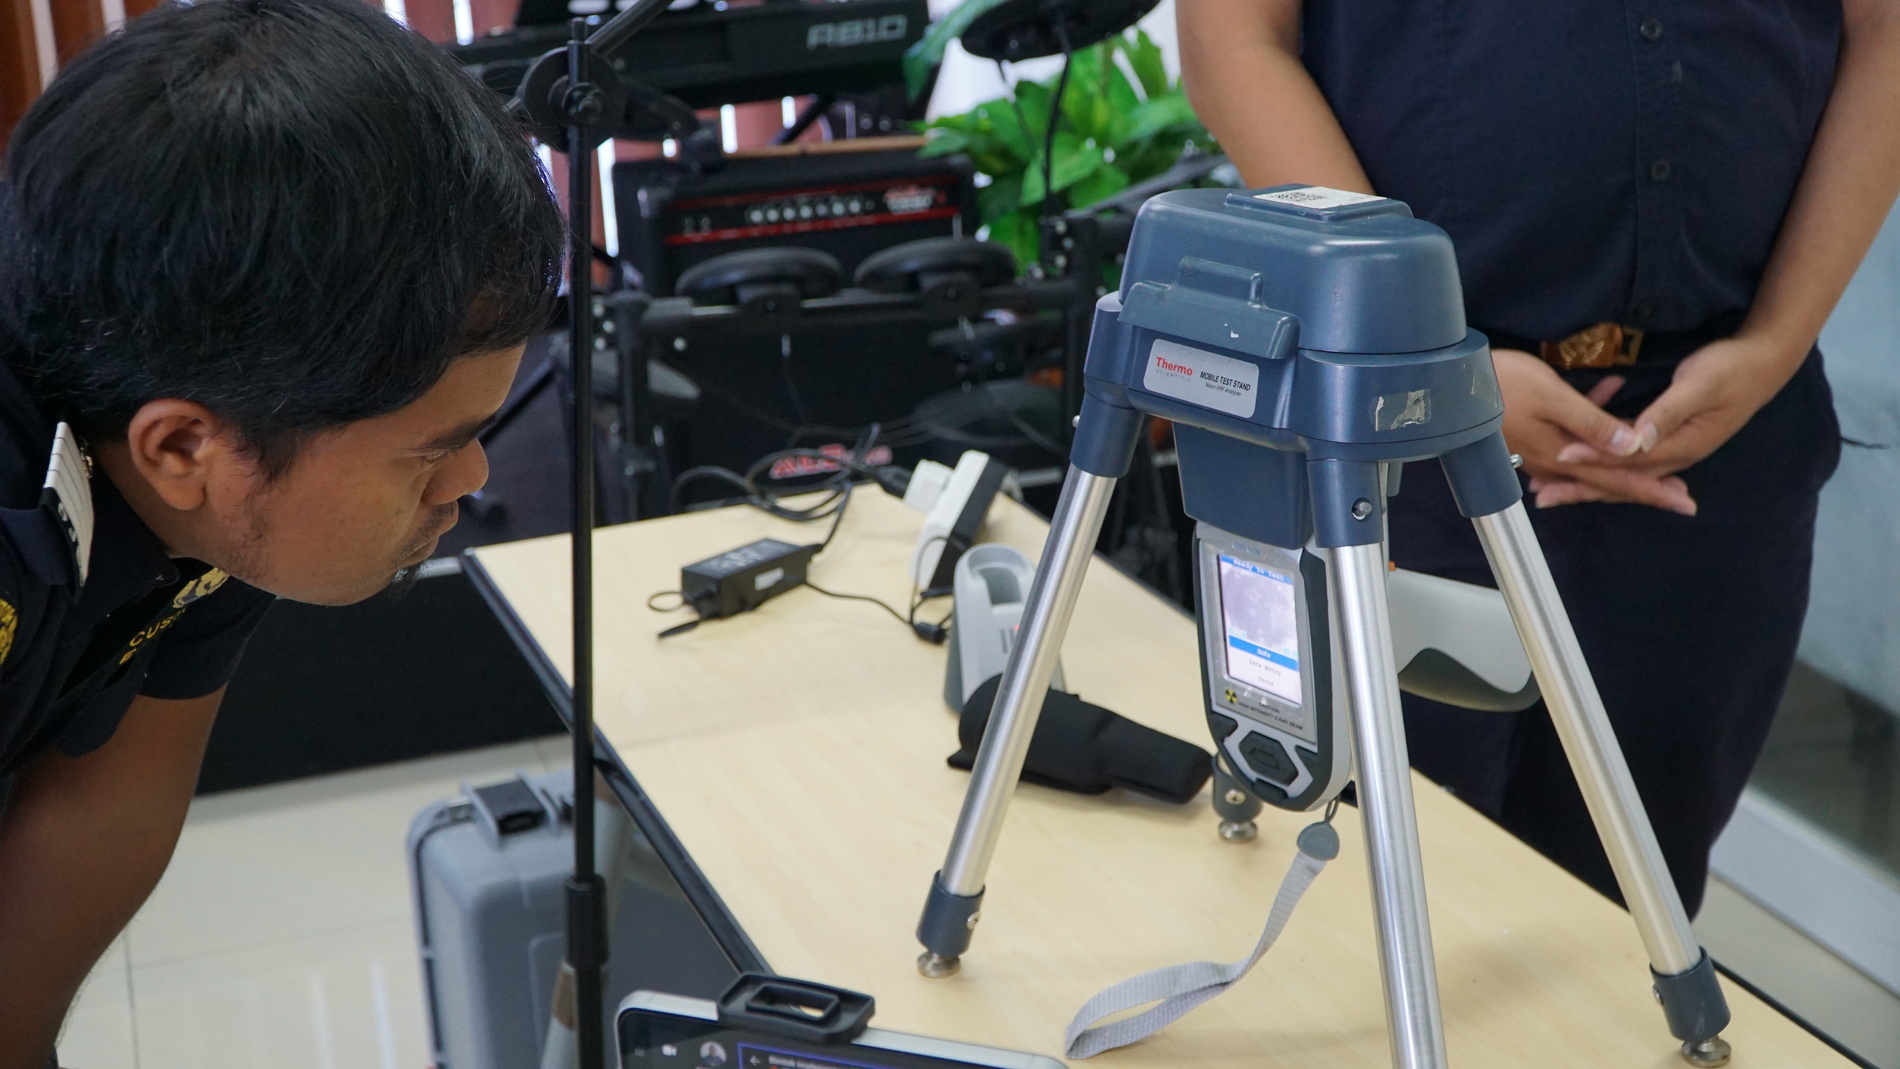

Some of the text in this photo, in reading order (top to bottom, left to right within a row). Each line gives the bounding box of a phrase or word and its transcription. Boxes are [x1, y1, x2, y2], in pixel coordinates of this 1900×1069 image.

[1156, 356, 1193, 376] Thermo
[1200, 371, 1251, 392] MOBILE TEST STAND
[1225, 387, 1242, 396] Analyzer
[1257, 648, 1271, 659] Info
